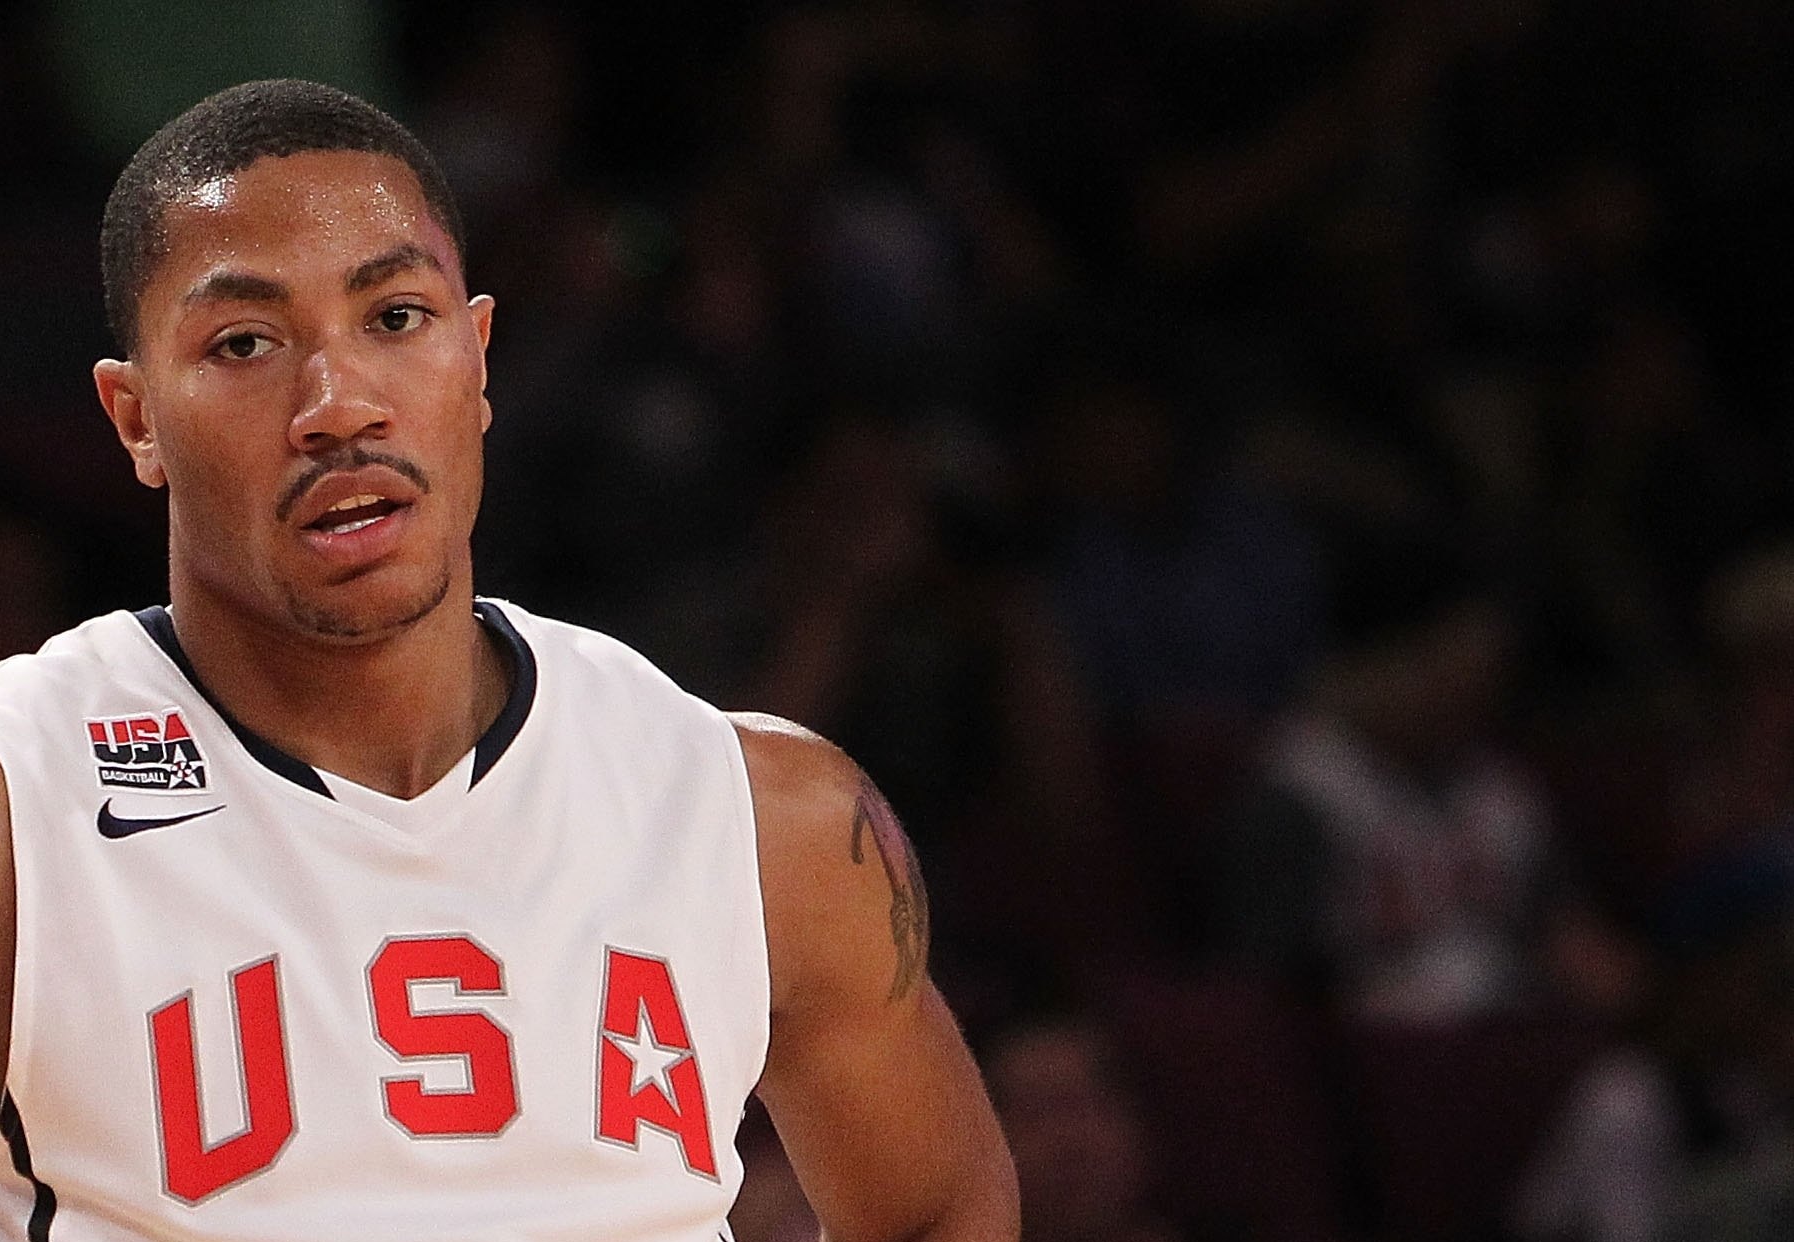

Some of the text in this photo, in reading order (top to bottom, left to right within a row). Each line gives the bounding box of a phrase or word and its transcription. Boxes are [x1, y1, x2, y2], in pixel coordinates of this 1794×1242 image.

[86, 712, 203, 764] USA
[101, 770, 168, 784] BASKETBALL
[146, 932, 721, 1208] USA
